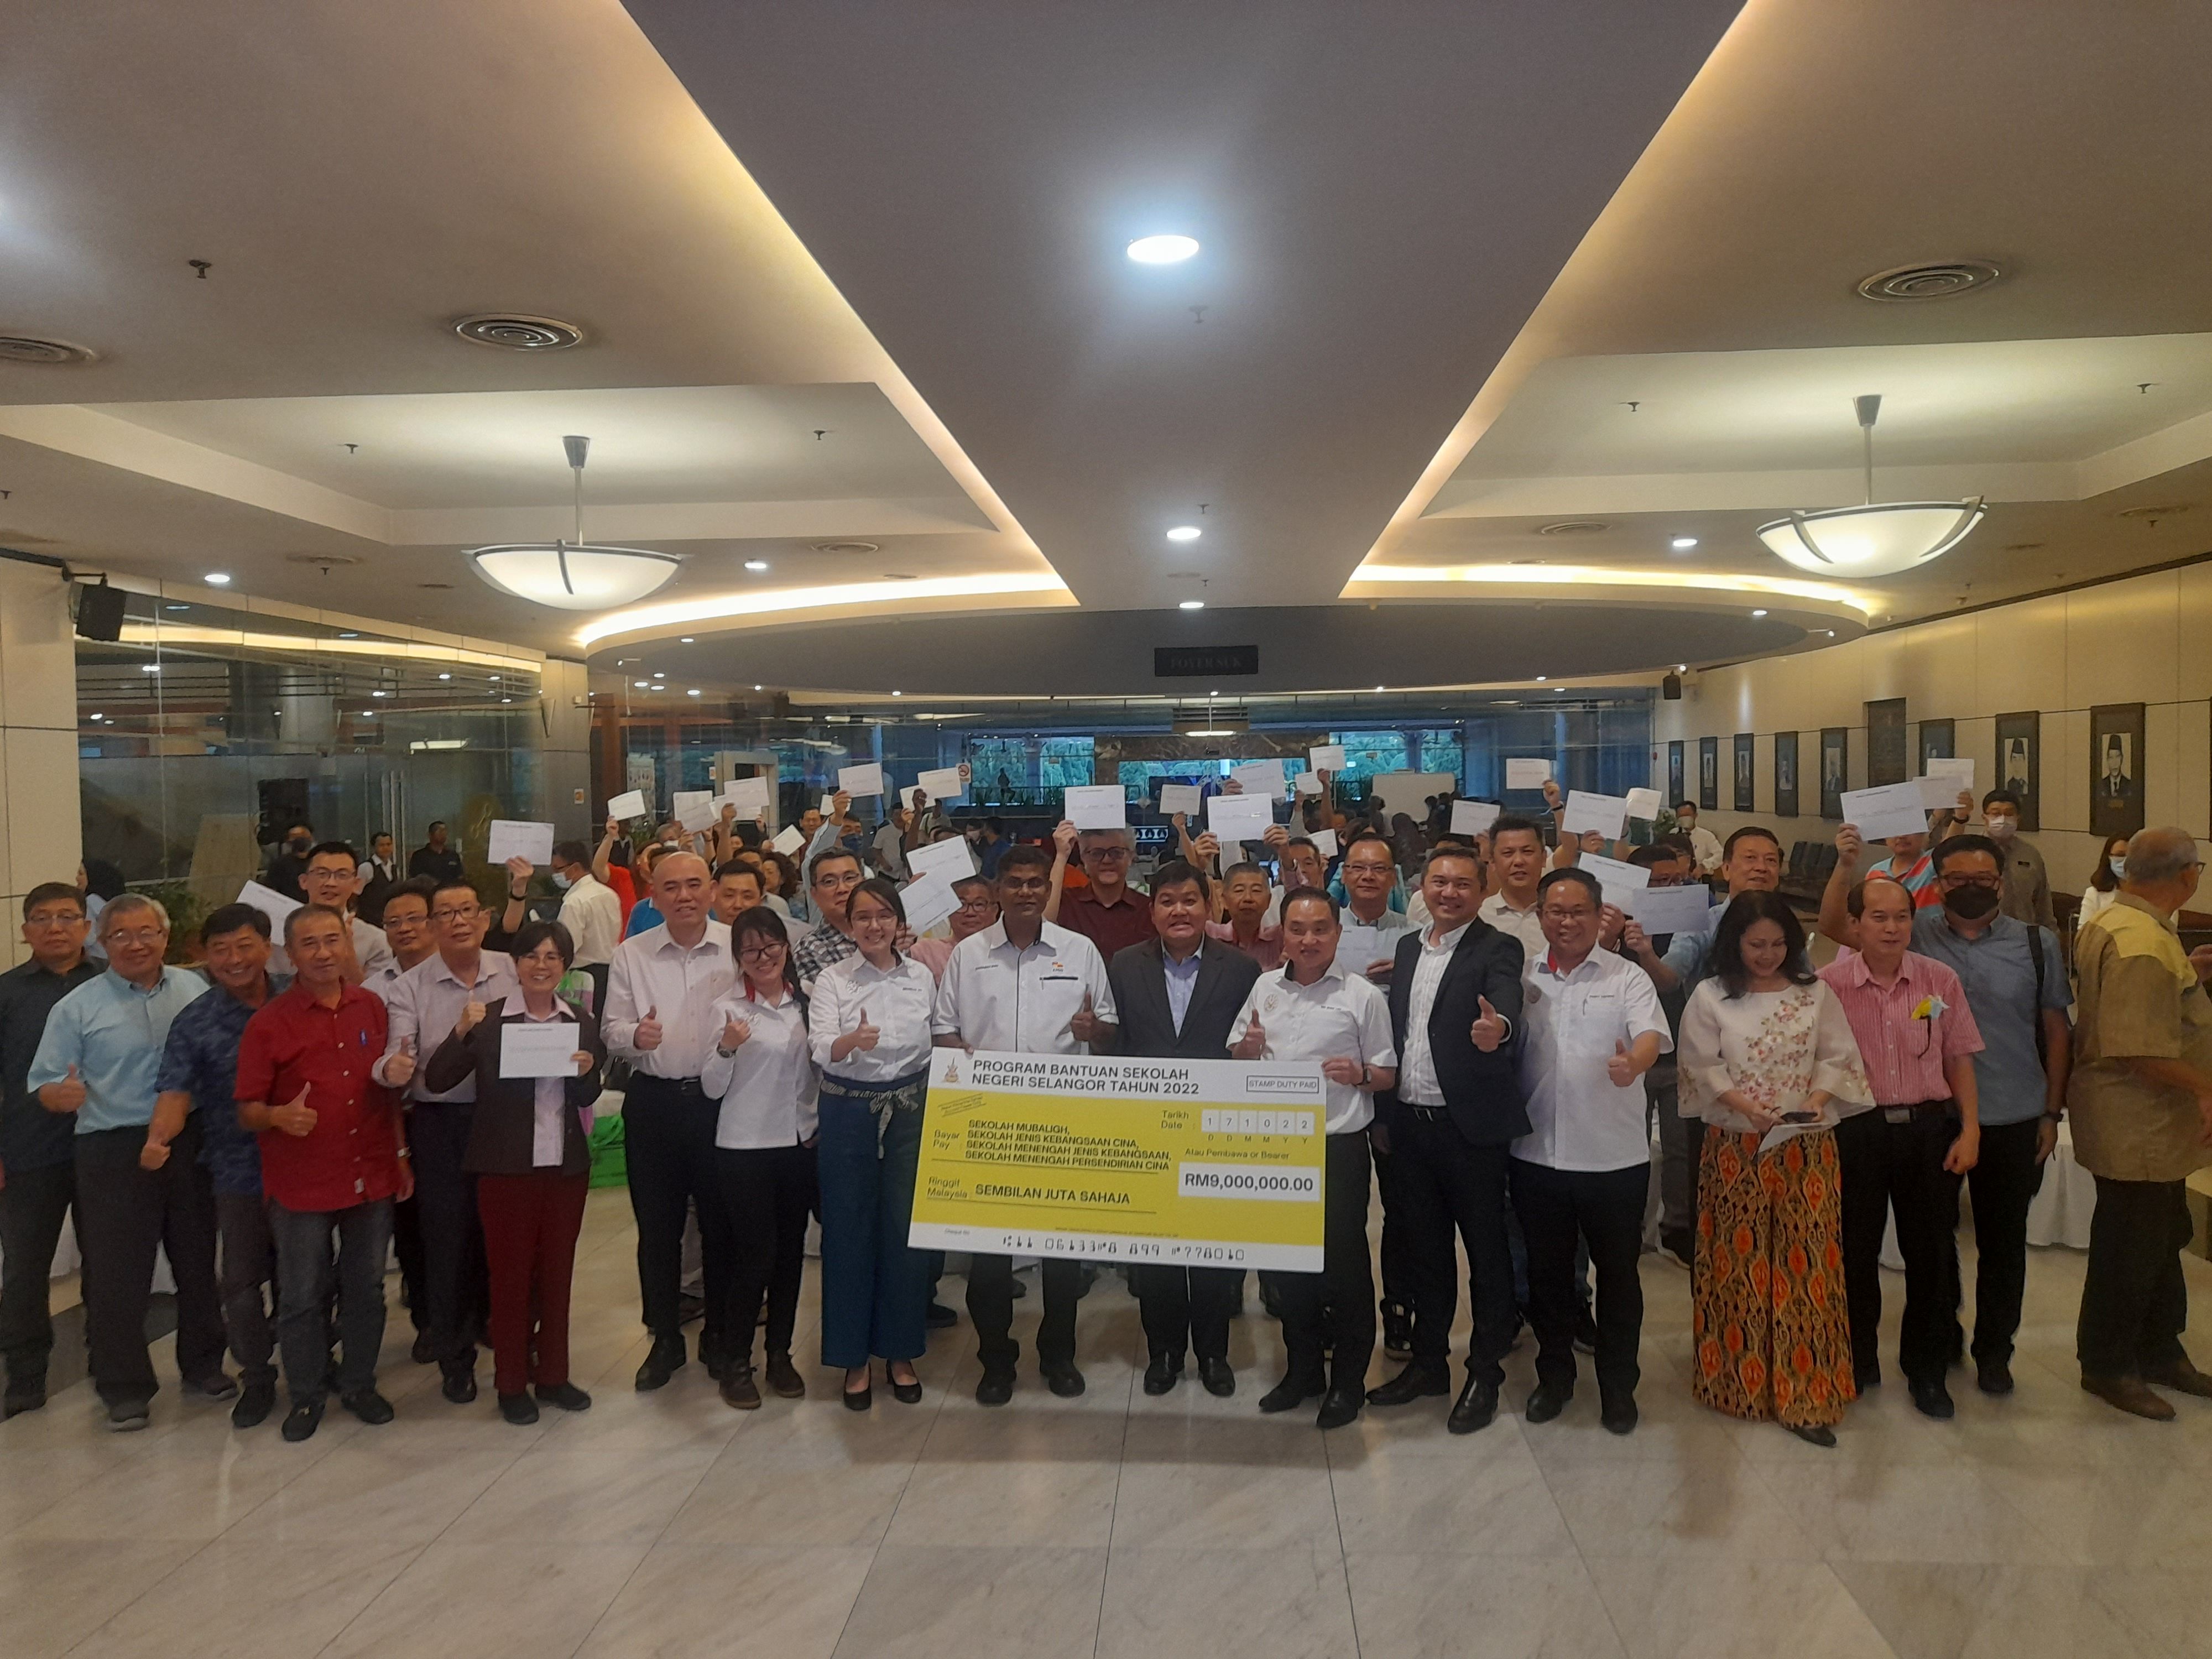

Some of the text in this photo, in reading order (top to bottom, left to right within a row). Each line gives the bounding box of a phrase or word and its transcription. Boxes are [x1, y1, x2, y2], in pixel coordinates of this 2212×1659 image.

[973, 1060, 1188, 1080] PROGRAM BANTUAN SEKOLAH
[972, 1073, 1199, 1094] NEGERI SELANGOR TAHUN 2022
[1162, 1110, 1189, 1119] Tarikh
[969, 1119, 1070, 1135] SEKOLAH MUBALIGH,
[1161, 1121, 1182, 1129] Date
[933, 1129, 960, 1140] Bayar
[968, 1129, 1139, 1150] SEKOLAH JENIS KEBANGSAAN CINA,
[932, 1139, 950, 1150] Pay
[966, 1140, 1172, 1161] SEKOLAH MENENGAH JENIS KEBANGSAAN,
[965, 1150, 1170, 1171] SEKOLAH MENENGAH PERSENDIRIAN CINA
[1185, 1148, 1204, 1156] Atau
[1206, 1149, 1248, 1158] Pembawa
[1261, 1151, 1290, 1160] Bearer
[928, 1176, 960, 1188] Ringgit
[1185, 1172, 1314, 1192] RM9,000,000.00
[927, 1187, 968, 1200] Malaysia
[975, 1183, 1130, 1204] SEMBILAN JUTA SAHAJA
